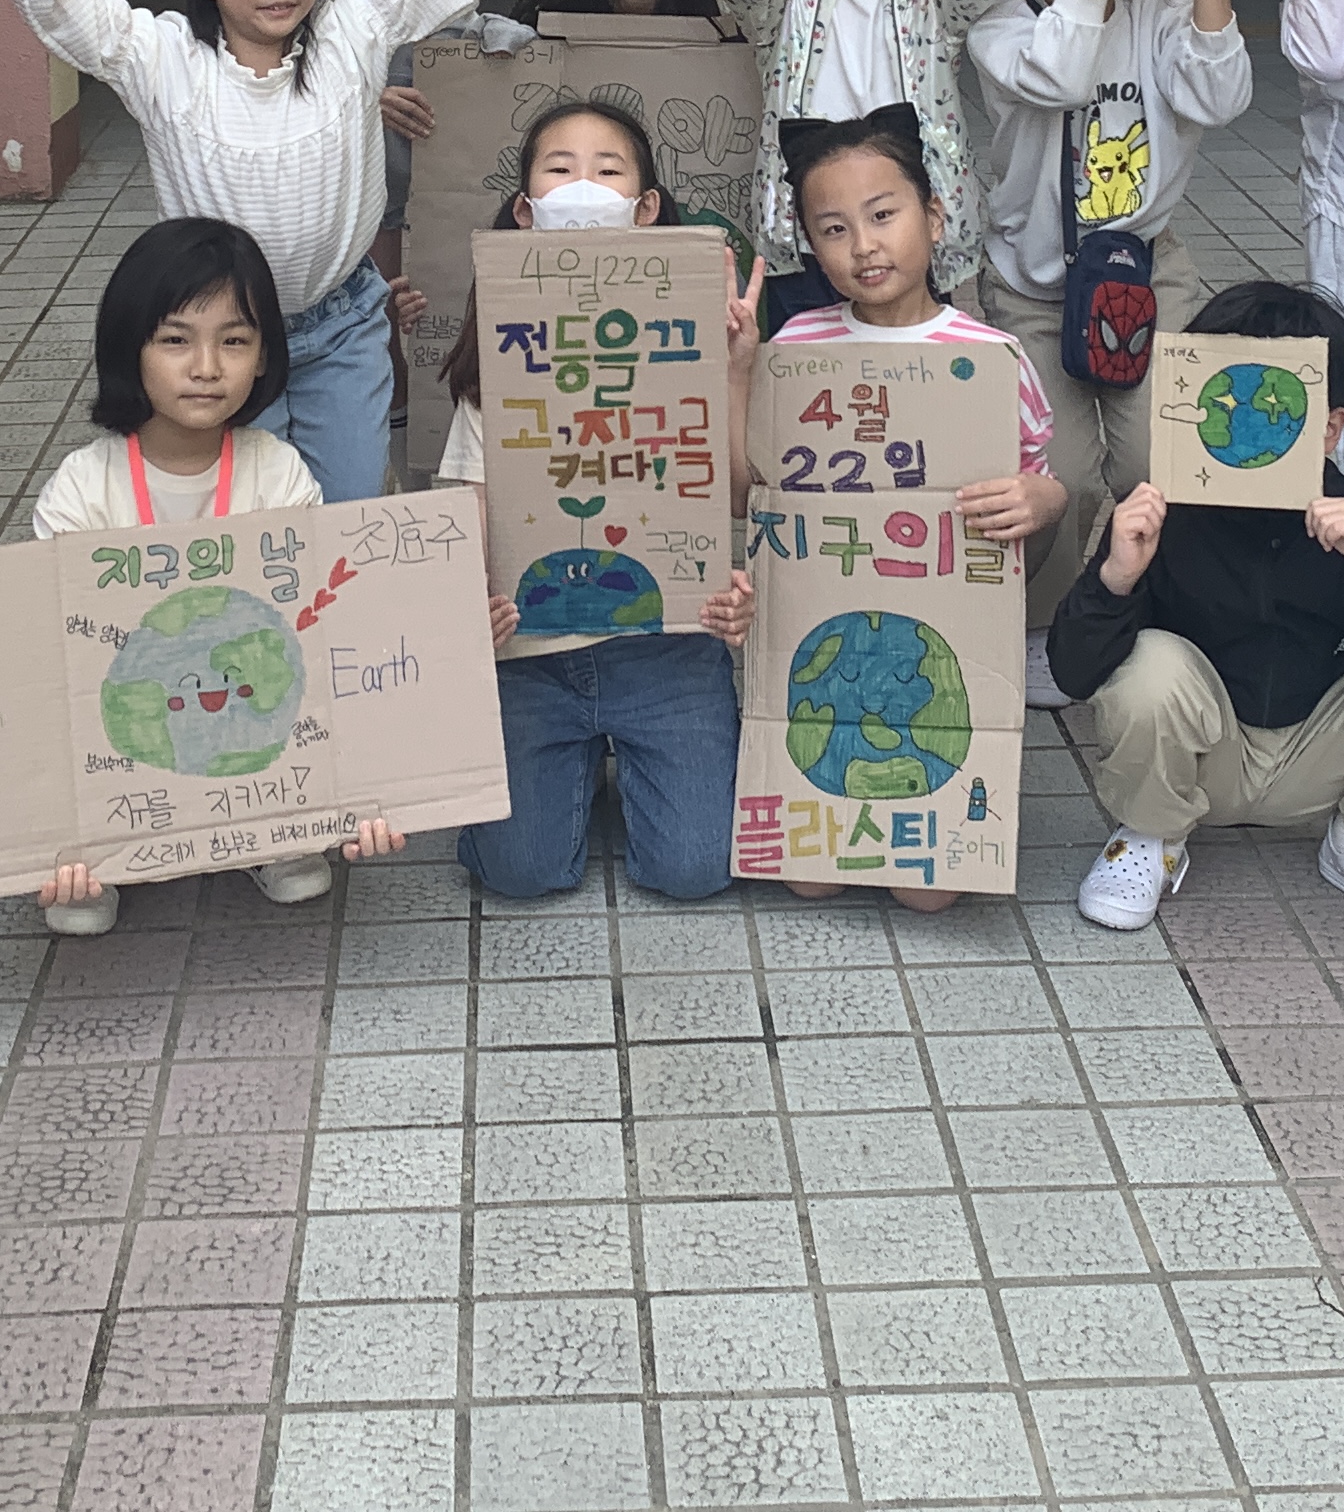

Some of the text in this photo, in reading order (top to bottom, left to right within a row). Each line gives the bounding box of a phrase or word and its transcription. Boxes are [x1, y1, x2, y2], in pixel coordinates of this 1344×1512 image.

[768, 353, 934, 384] Green Earth
[91, 527, 306, 603] 지구의 날
[329, 635, 420, 699] Earth
[106, 789, 177, 829] 지구를
[126, 840, 196, 872] 쓰레기
[209, 831, 261, 862] 함부로
